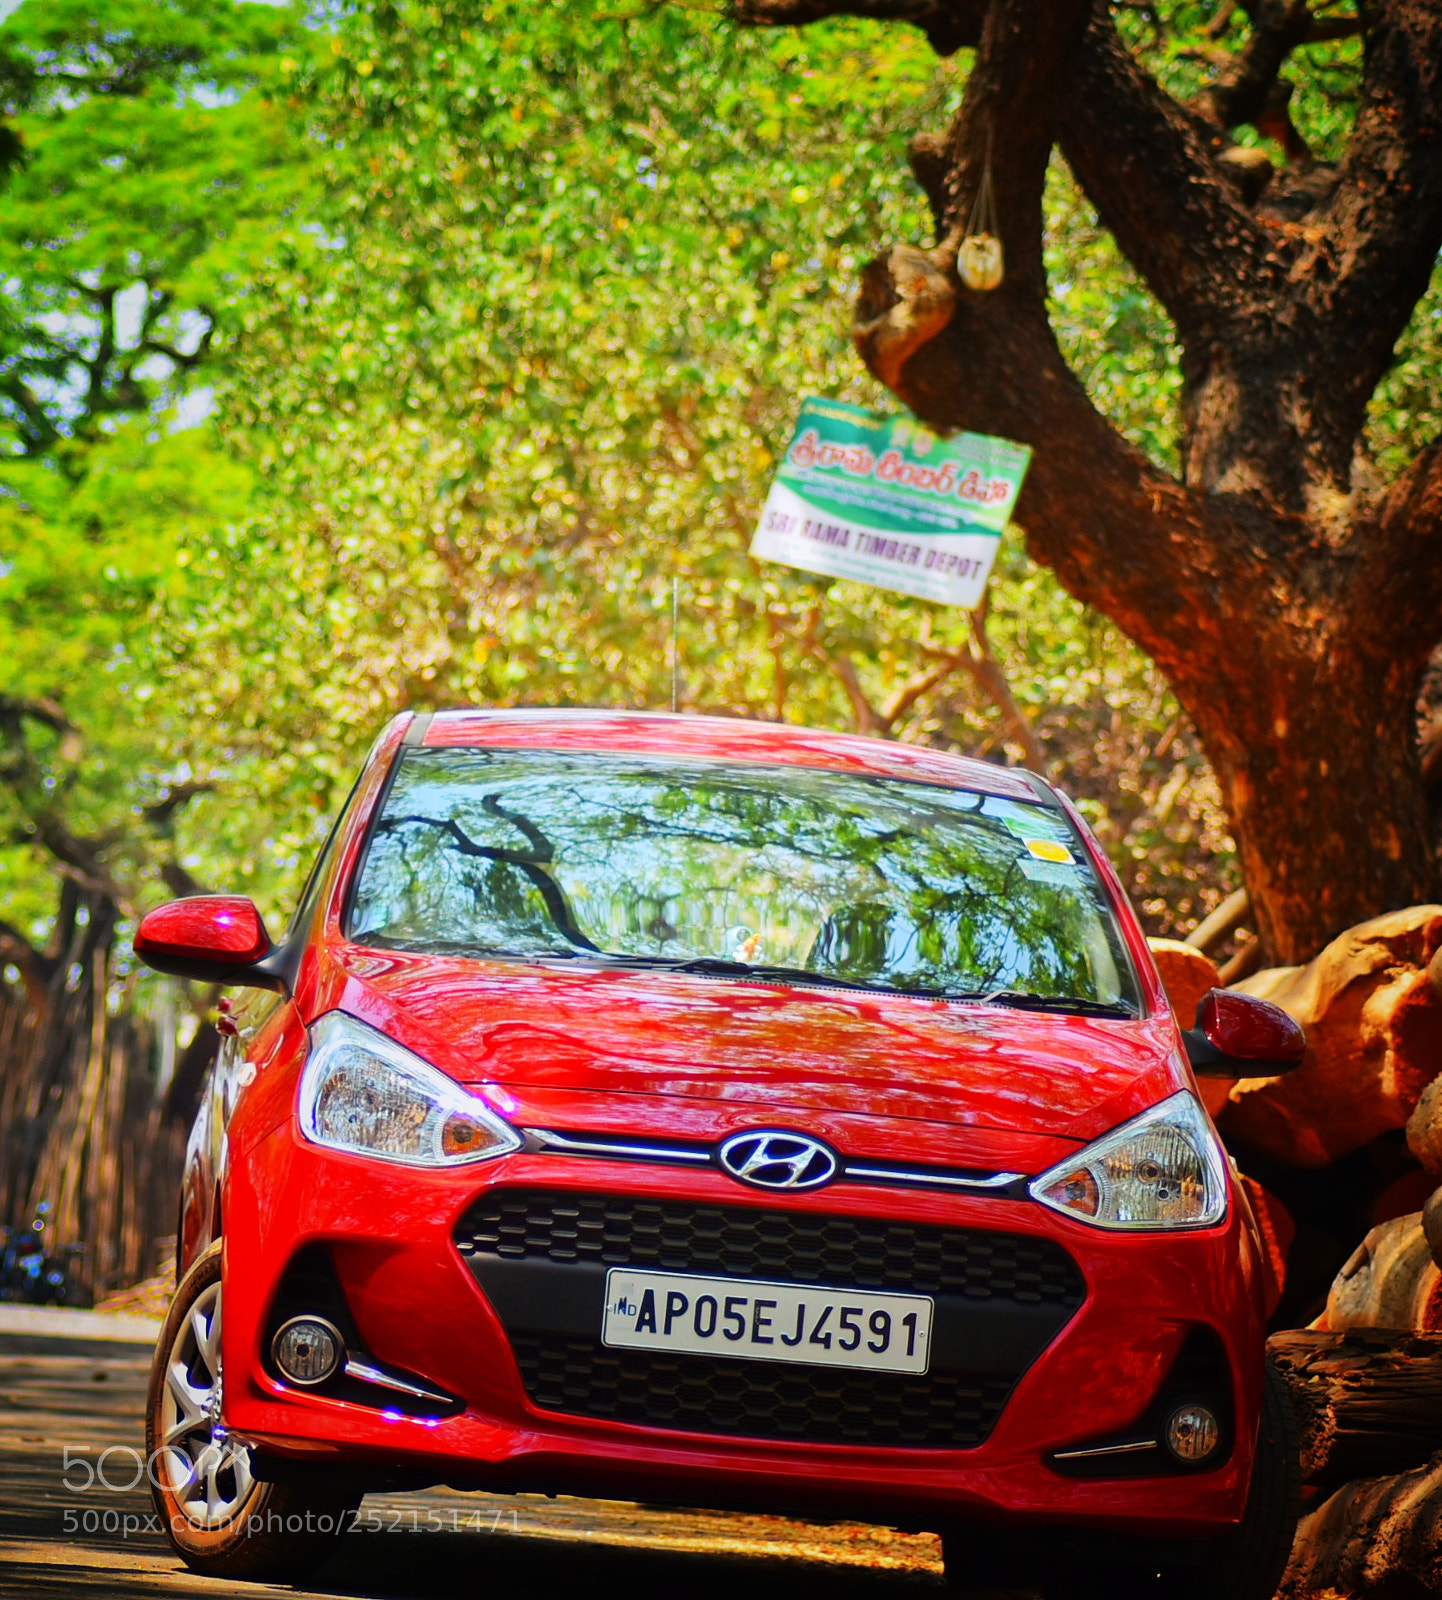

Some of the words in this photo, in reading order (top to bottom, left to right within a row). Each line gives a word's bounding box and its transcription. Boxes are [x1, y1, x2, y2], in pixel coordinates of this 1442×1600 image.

[766, 511, 798, 535] SRI
[801, 520, 851, 548] RAMA
[855, 532, 922, 565] TIMBER
[923, 549, 983, 580] DEPOT
[634, 1288, 919, 1356] AP05EJ4591
